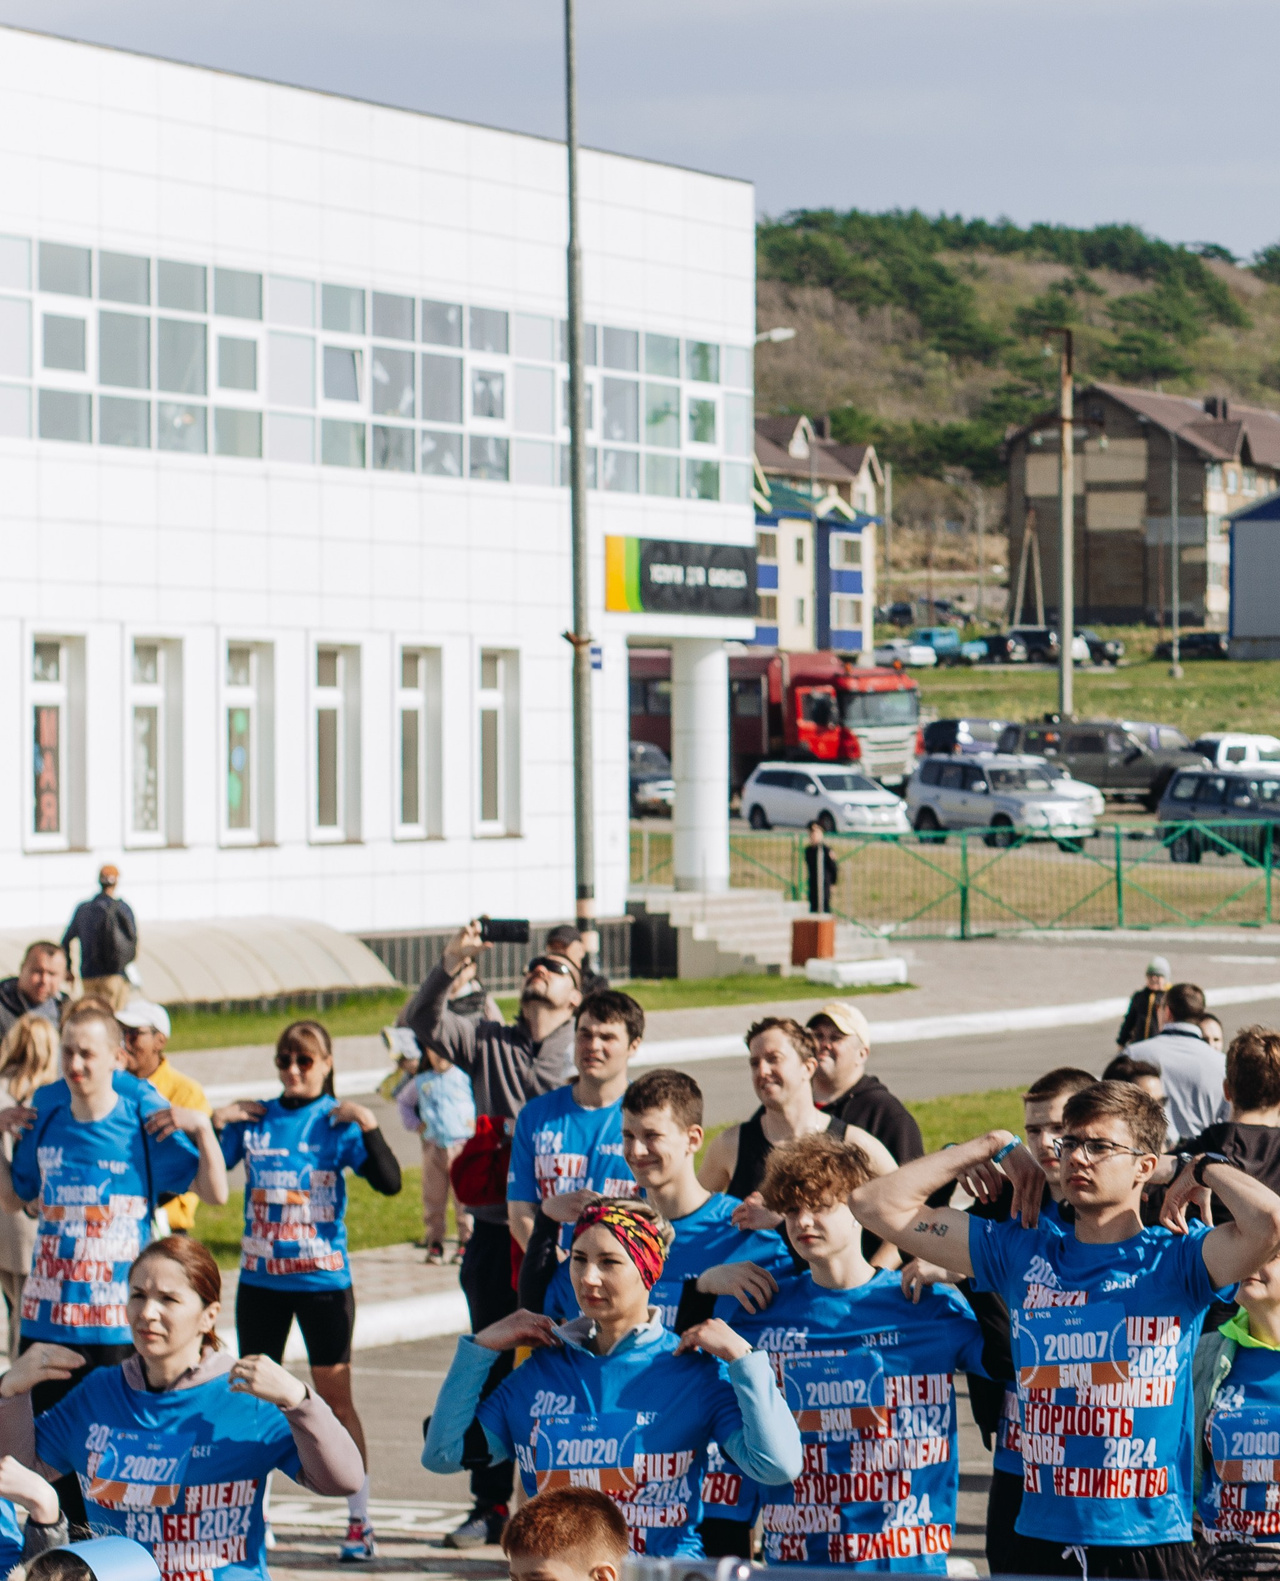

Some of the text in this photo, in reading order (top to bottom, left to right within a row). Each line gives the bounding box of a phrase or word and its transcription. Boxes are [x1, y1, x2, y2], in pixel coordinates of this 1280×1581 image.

[1043, 1331, 1109, 1362] 20007
[1126, 1316, 1181, 1346] ЦЕЛЬ
[806, 1379, 869, 1407] 20002
[1024, 1403, 1134, 1437] #ГОРДОСТЬ
[556, 1438, 618, 1466] 20020
[1103, 1437, 1157, 1468] 2024
[119, 1454, 179, 1482] 20027
[1053, 1465, 1169, 1499] #ЕДИНСТВО
[185, 1480, 258, 1513] #ЦЕЛЬ
[793, 1470, 911, 1504] #ГОРДОСТЬ
